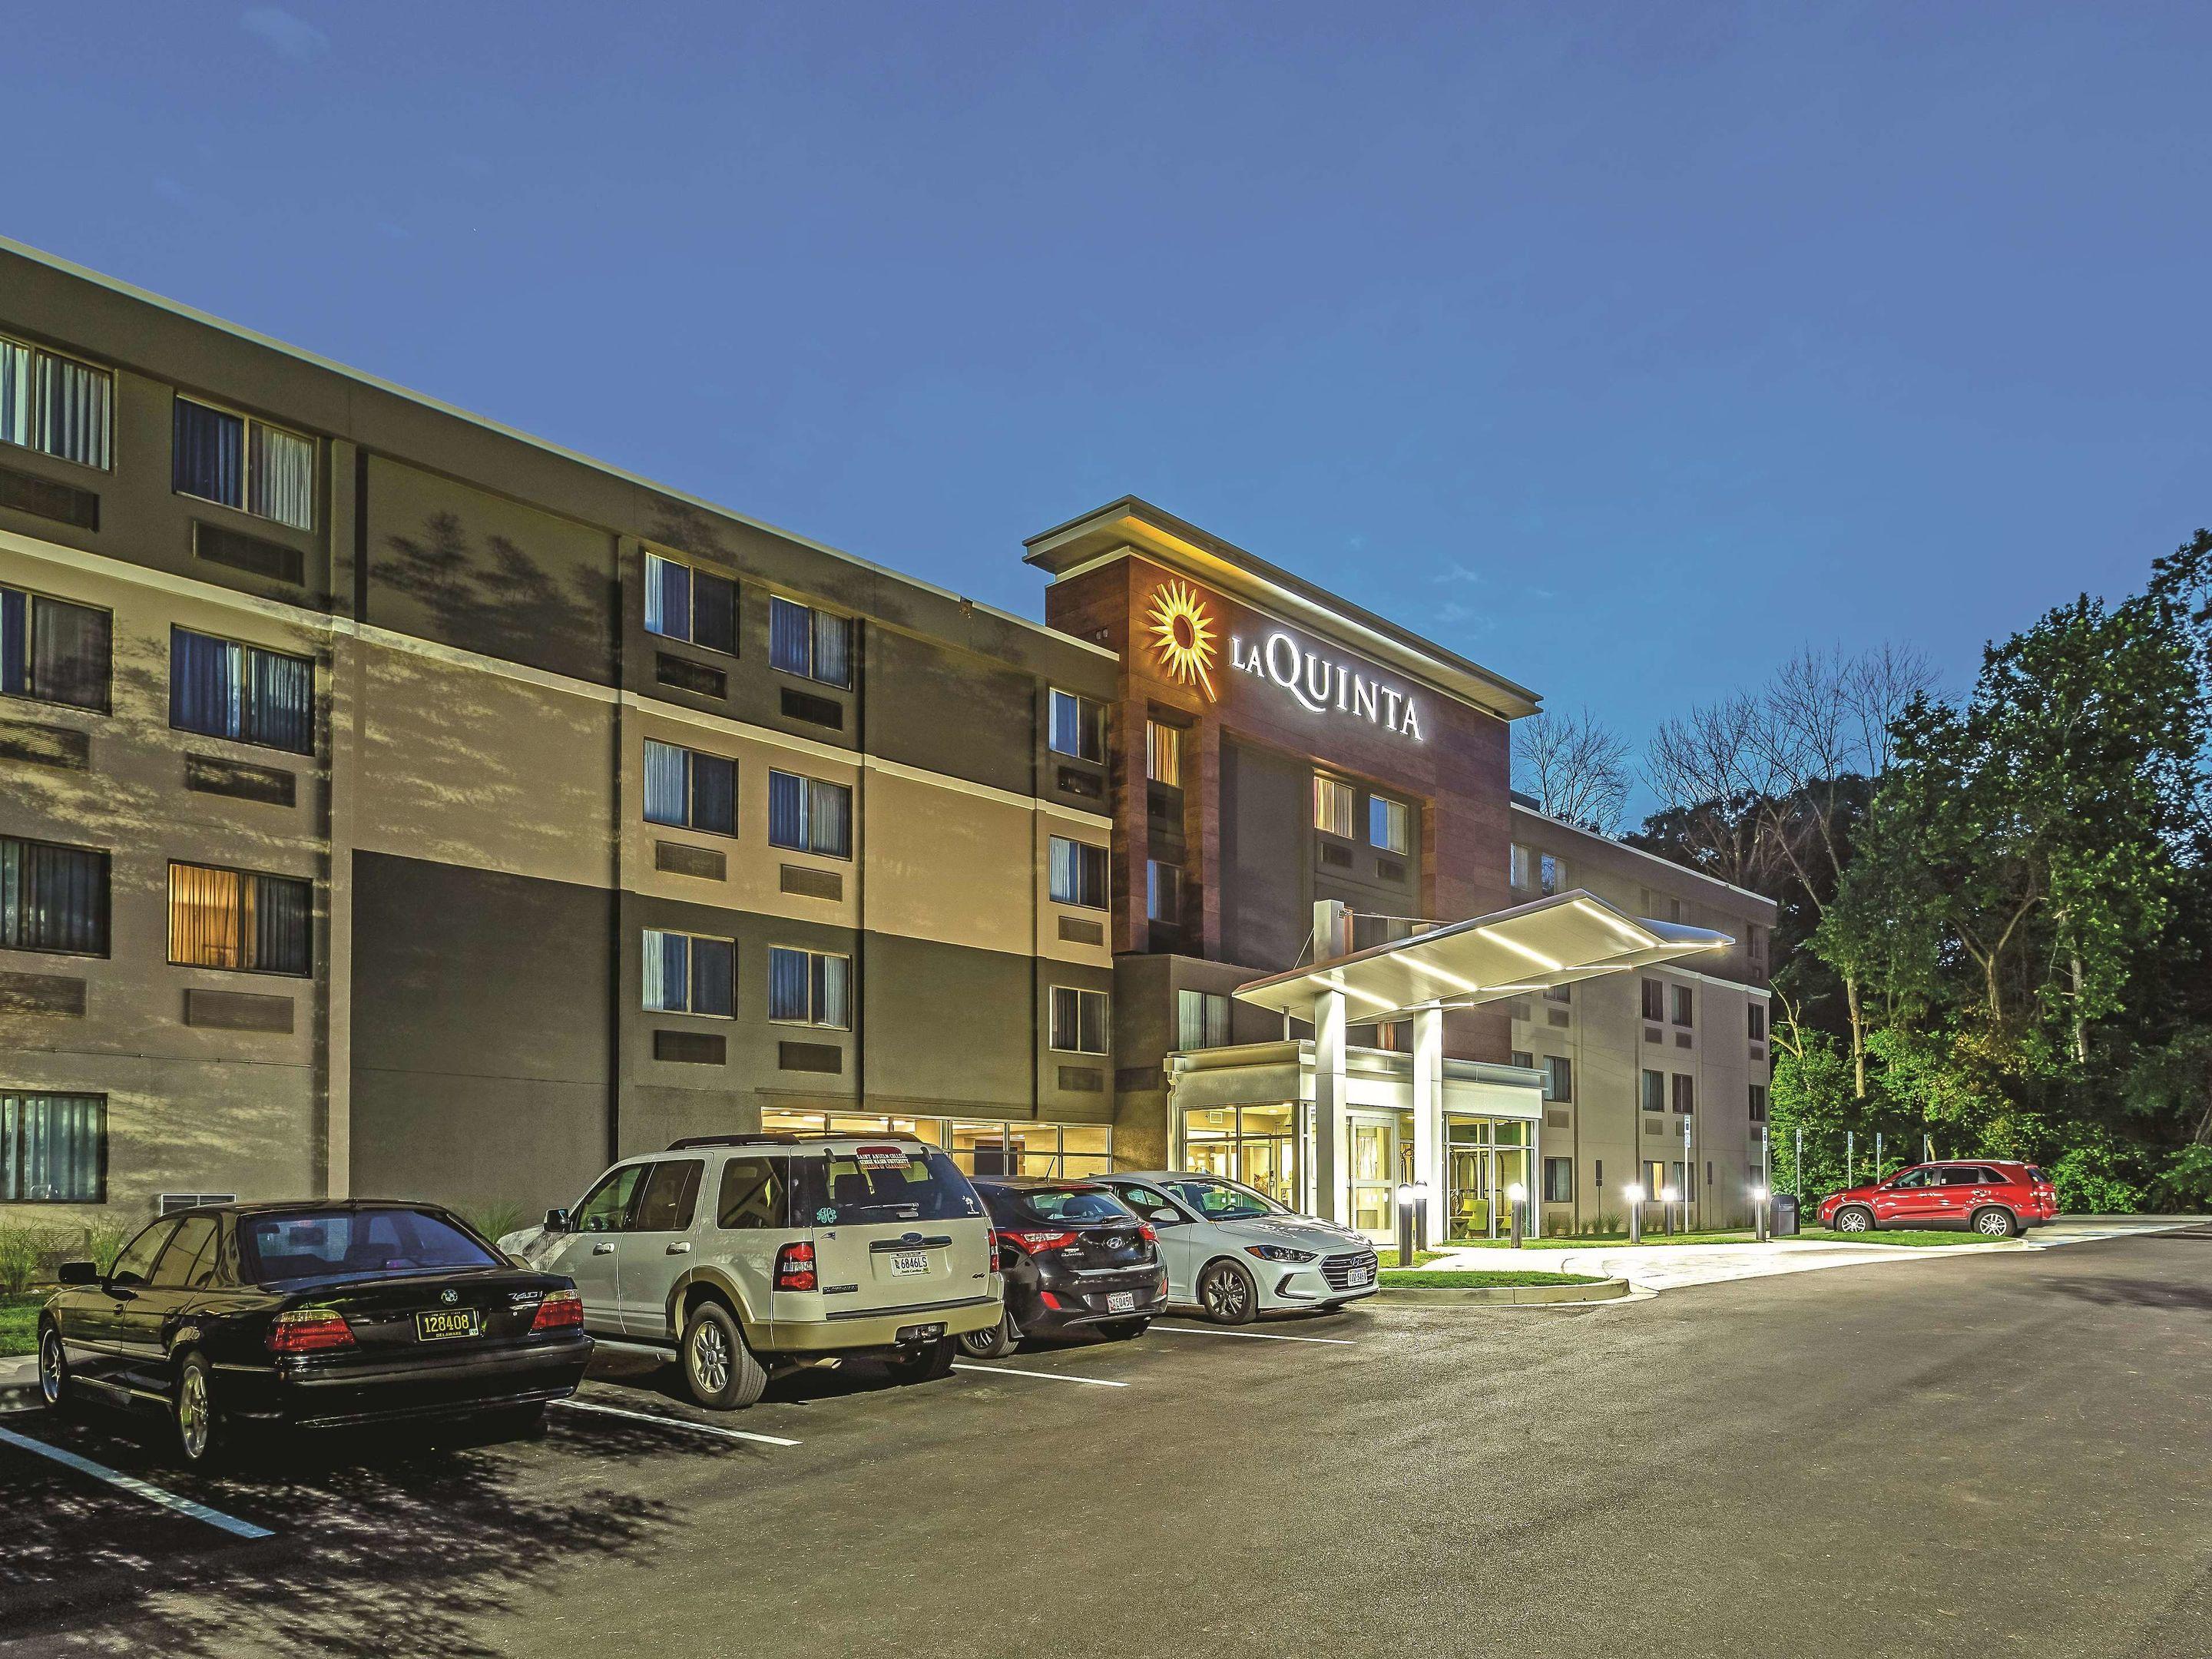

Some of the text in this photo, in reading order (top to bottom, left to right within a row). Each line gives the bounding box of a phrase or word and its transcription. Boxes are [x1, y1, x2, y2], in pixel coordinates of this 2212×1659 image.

[1230, 632, 1423, 741] LA QUINTA
[425, 1314, 469, 1333] 128408
